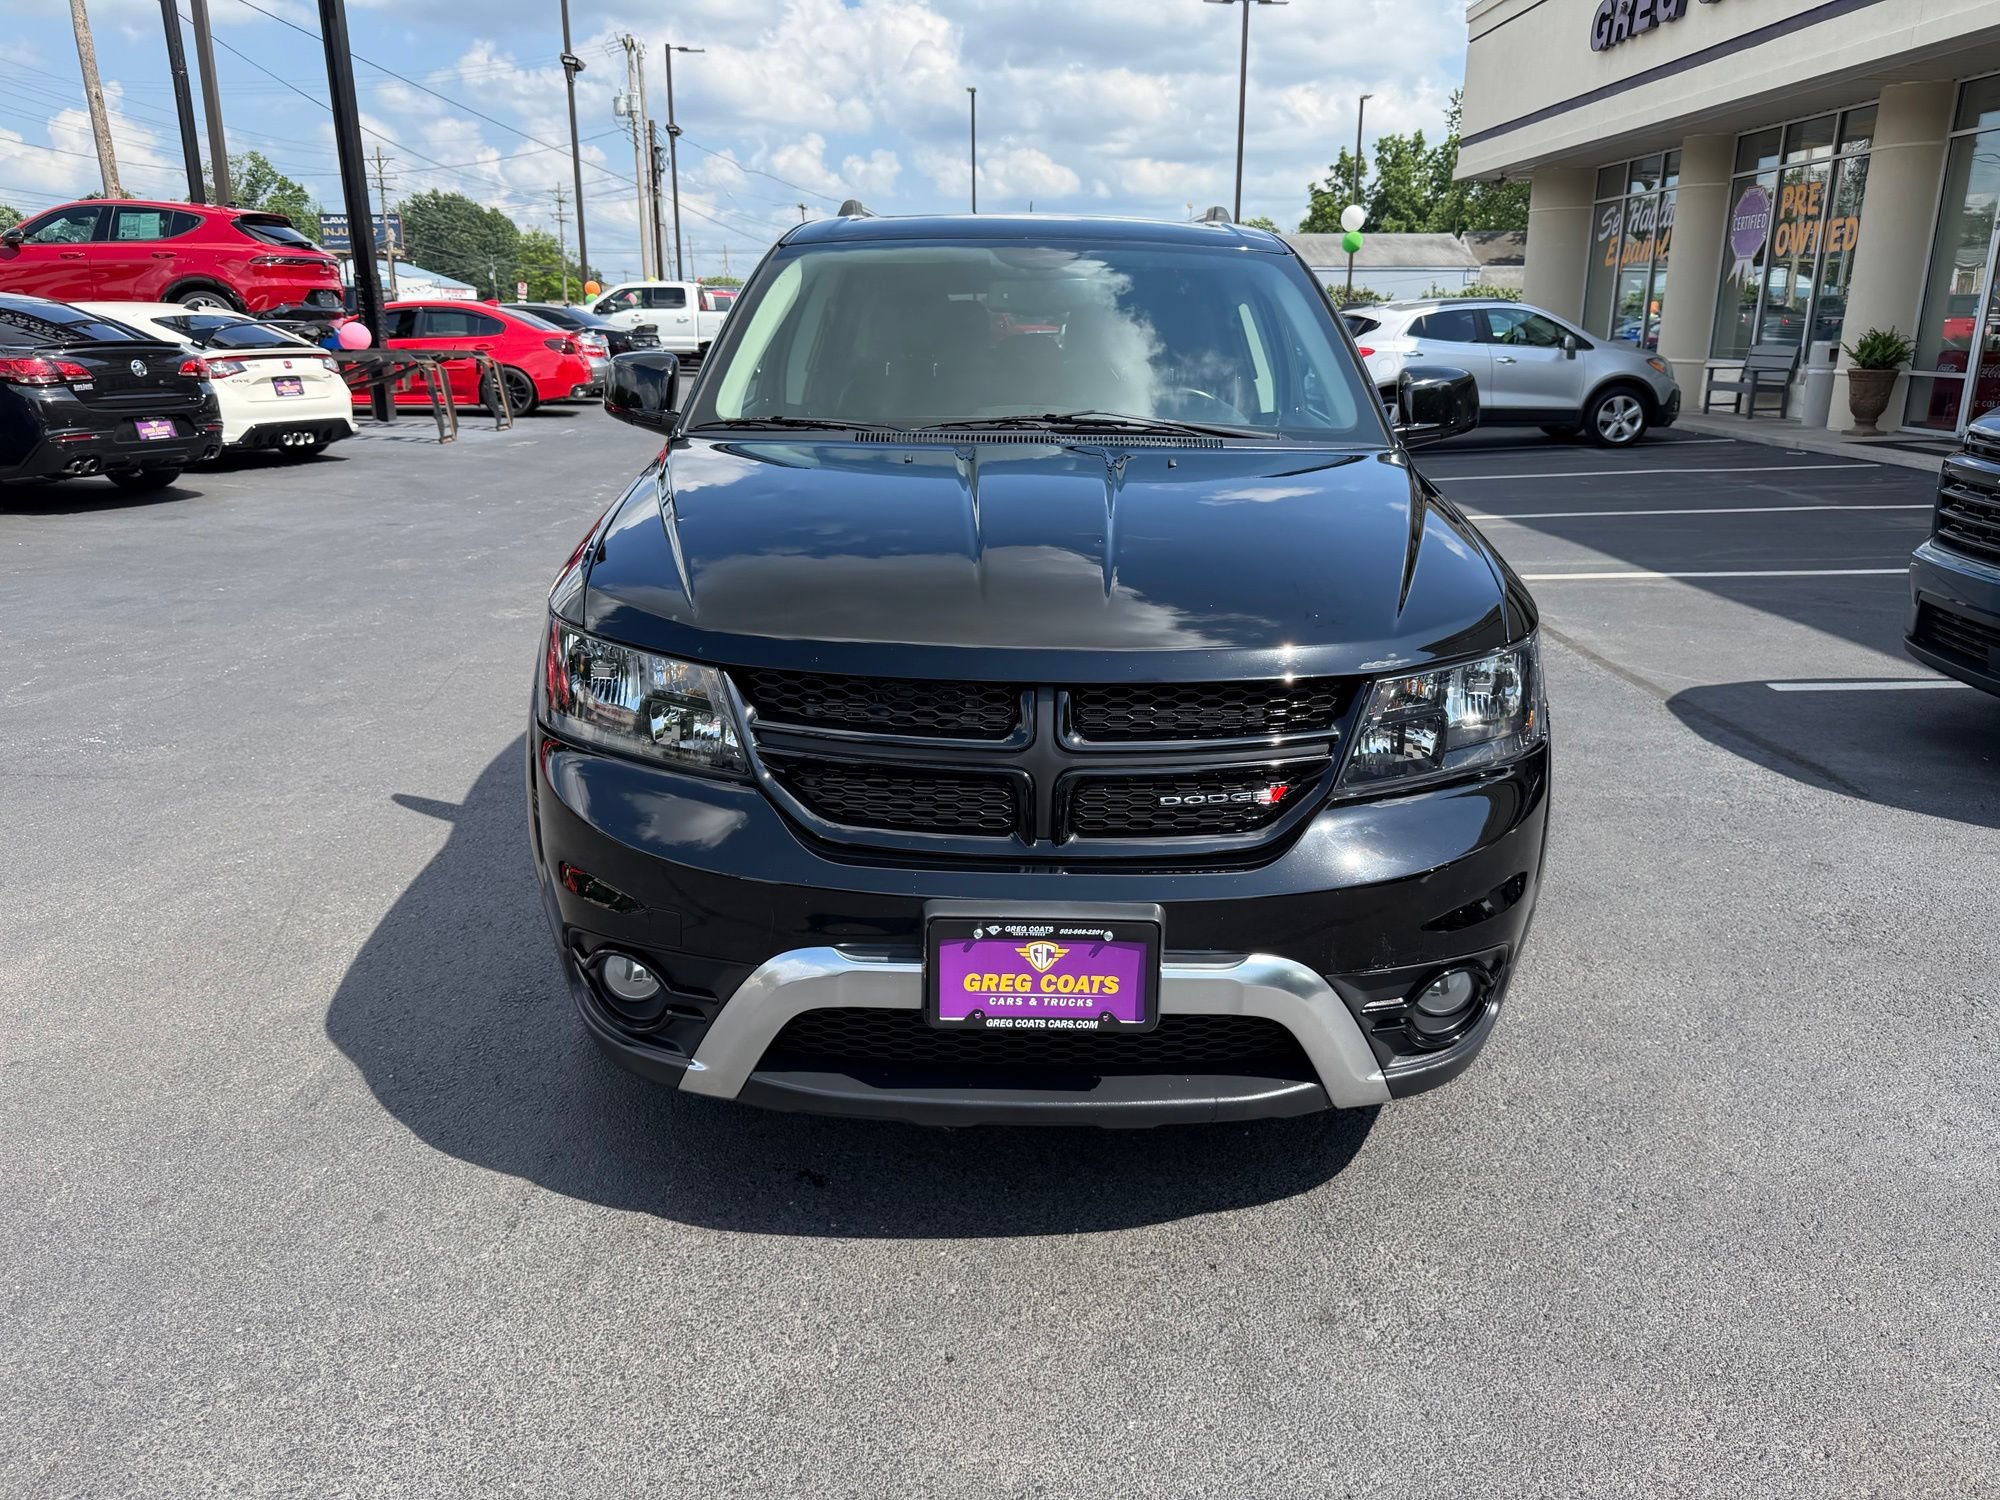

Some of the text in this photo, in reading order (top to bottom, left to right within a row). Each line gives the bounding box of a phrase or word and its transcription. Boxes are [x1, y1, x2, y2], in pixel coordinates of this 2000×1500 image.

[1598, 206, 1620, 242] Se
[1733, 213, 1767, 231] CERTIFIED
[1159, 789, 1272, 805] DODGE
[963, 973, 1120, 994] GREG COATS
[989, 997, 1093, 1007] CARS & TRUCKS
[986, 1019, 1099, 1029] GREG COATS CARS.COM
